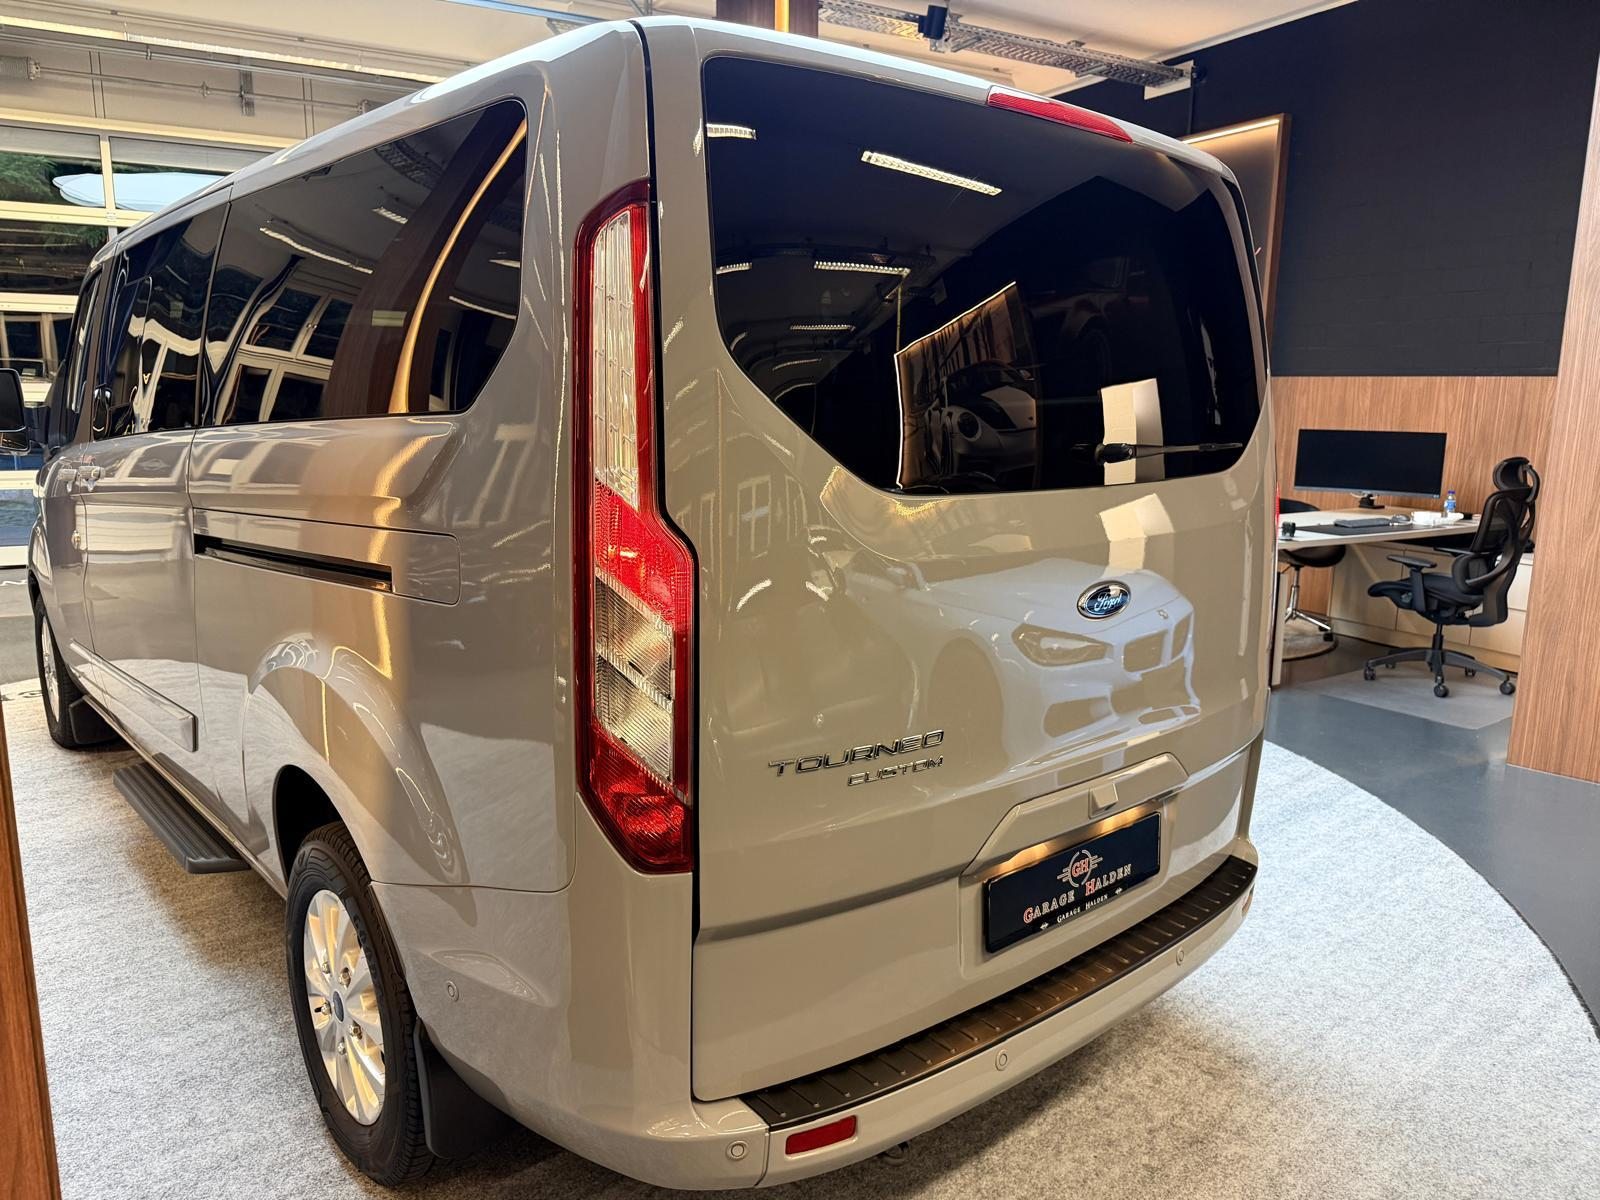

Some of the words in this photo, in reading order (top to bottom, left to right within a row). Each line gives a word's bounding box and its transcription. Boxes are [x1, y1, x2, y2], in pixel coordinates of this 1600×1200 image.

[1094, 592, 1123, 612] Ford
[768, 729, 945, 777] TOURNEO
[847, 755, 944, 787] CUSTOM
[1071, 857, 1090, 878] GH
[1023, 889, 1076, 924] GARAGE
[1084, 863, 1133, 897] HALDEN
